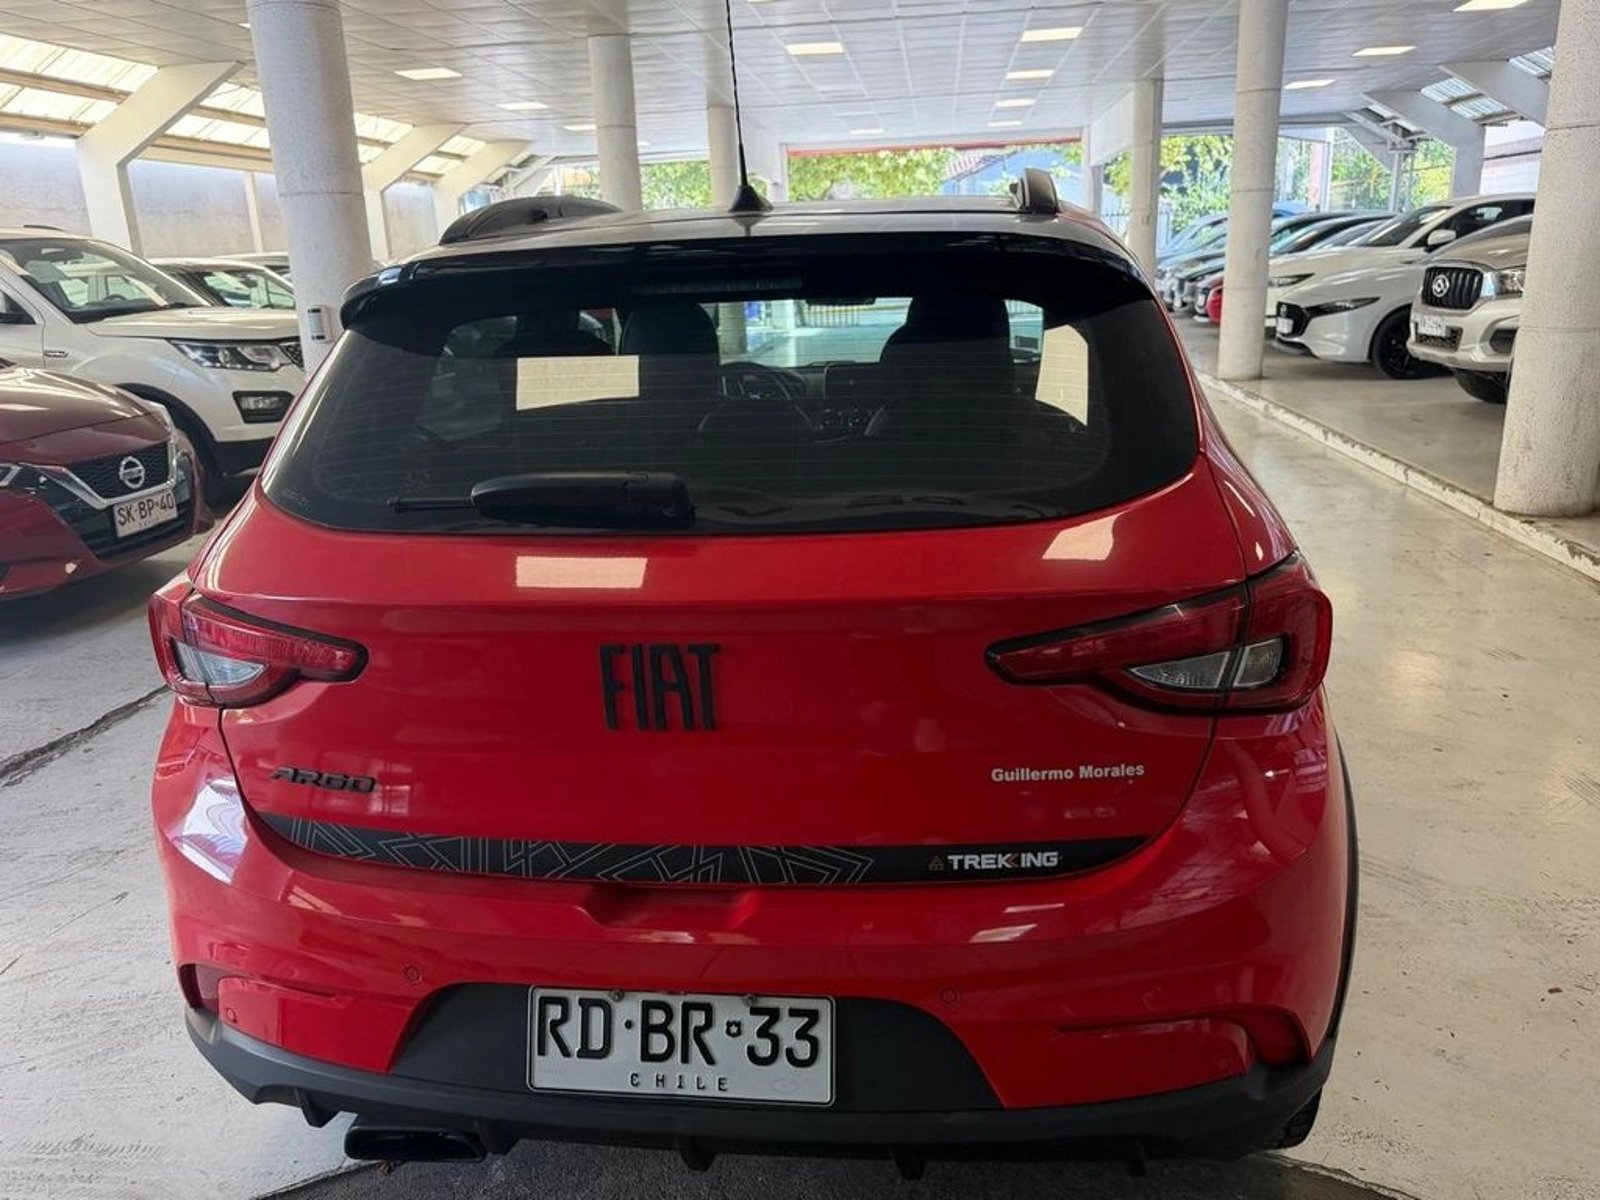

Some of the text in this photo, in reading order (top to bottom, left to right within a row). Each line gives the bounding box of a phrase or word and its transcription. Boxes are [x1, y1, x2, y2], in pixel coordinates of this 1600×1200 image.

[599, 643, 721, 731] FIAT
[270, 766, 376, 793] ARGO
[991, 764, 1145, 782] Guillermo Morales
[630, 1072, 729, 1092] CHILE
